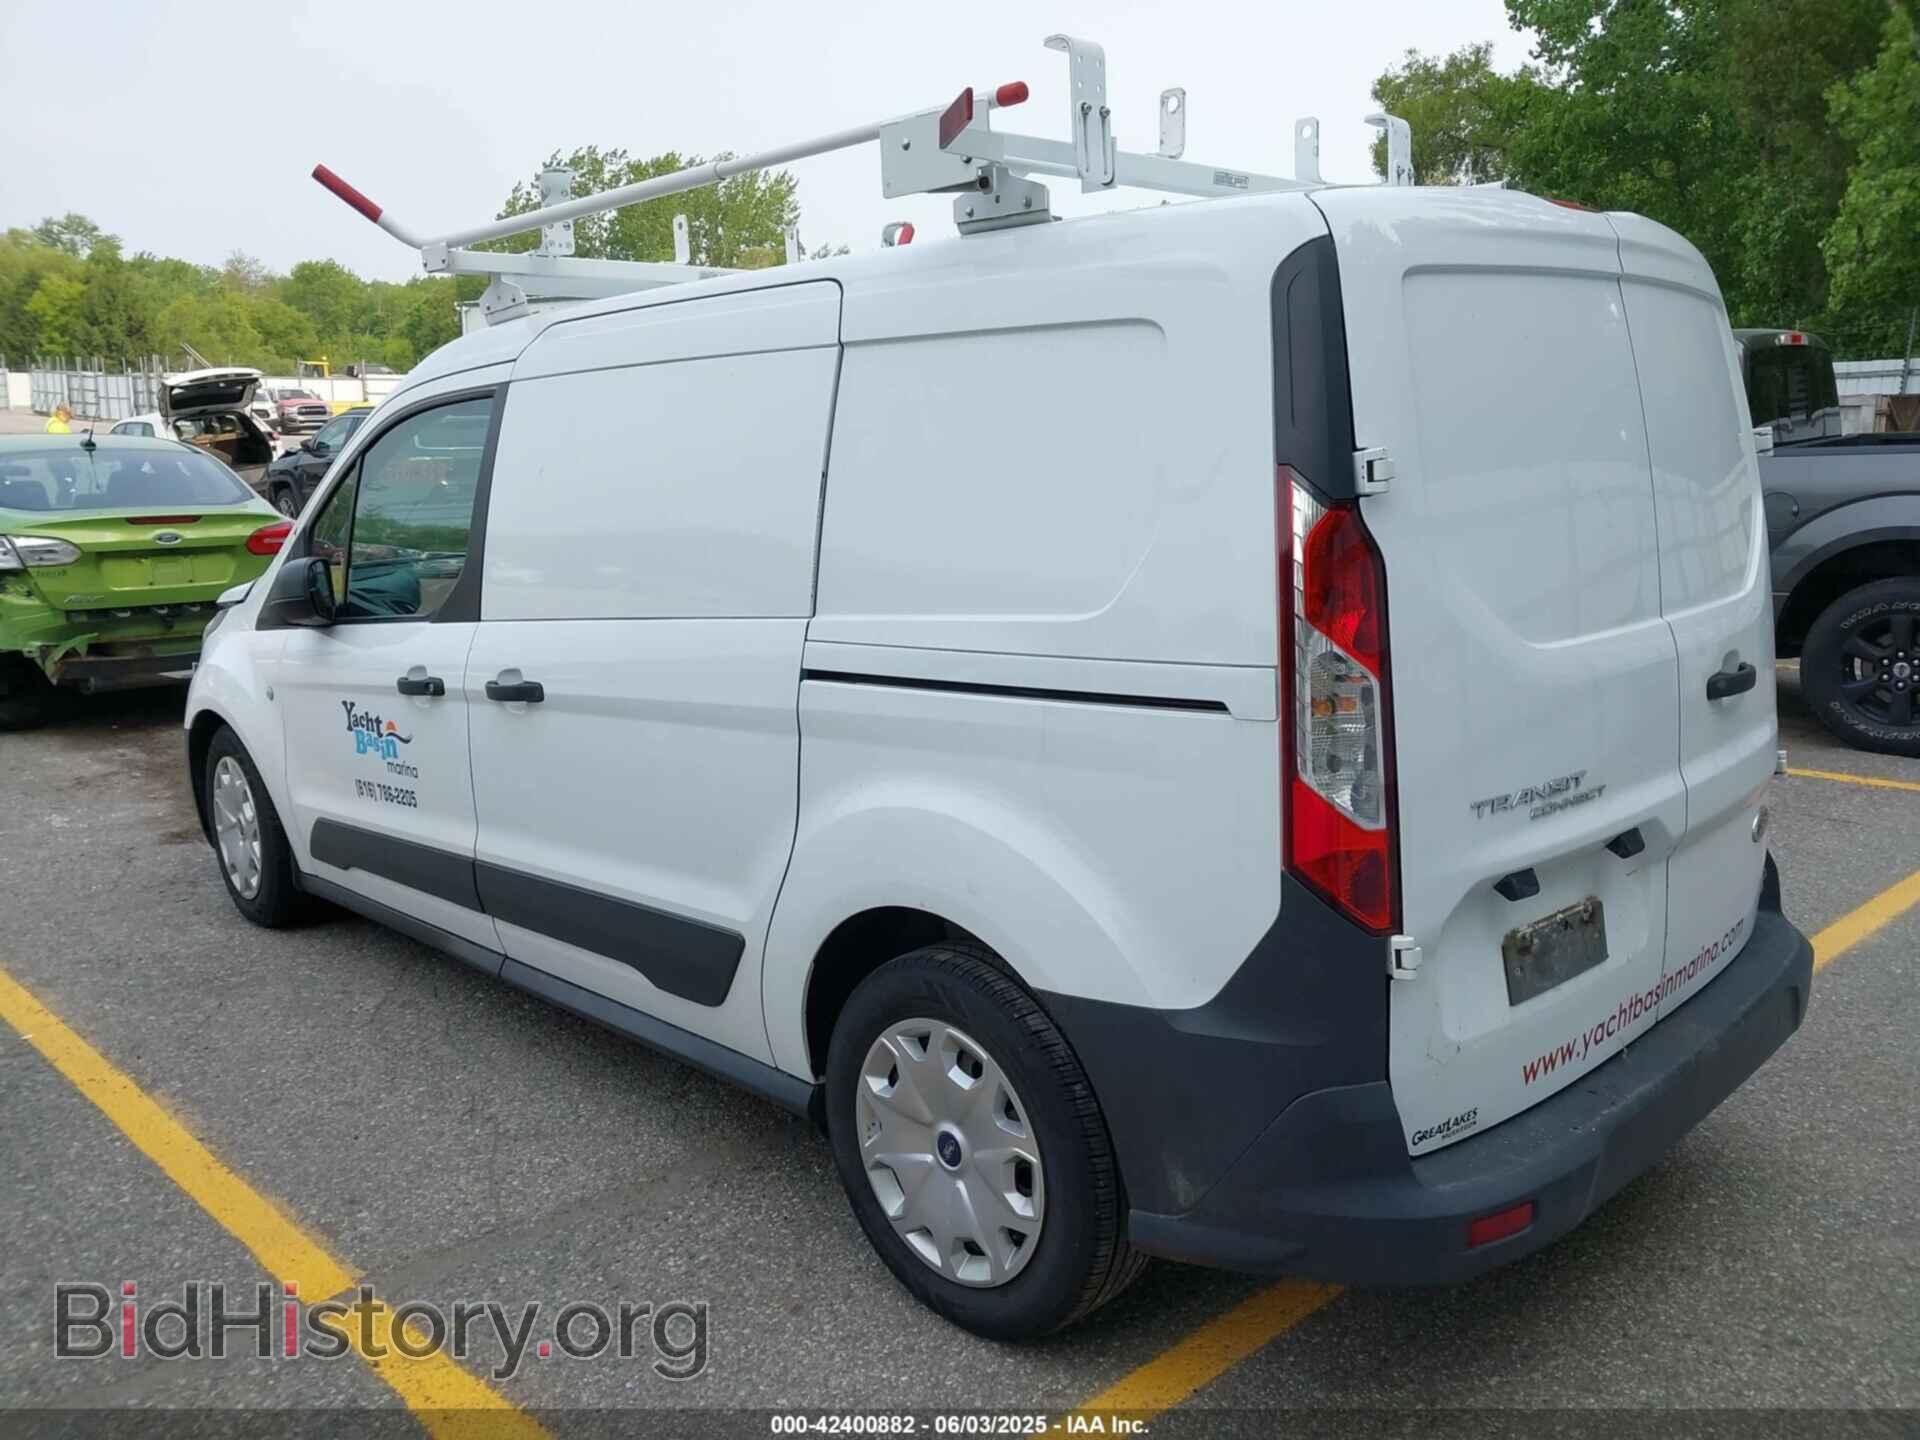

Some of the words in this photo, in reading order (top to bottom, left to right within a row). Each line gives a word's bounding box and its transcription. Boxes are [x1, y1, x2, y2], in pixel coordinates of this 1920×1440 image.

[342, 700, 384, 738] Yacht
[354, 730, 398, 760] Basin
[386, 761, 418, 778] marina
[1470, 769, 1587, 819] TRANSIT
[1529, 784, 1606, 820] CONNECT
[1522, 917, 1745, 1086] www.yachtbasinmarina.com
